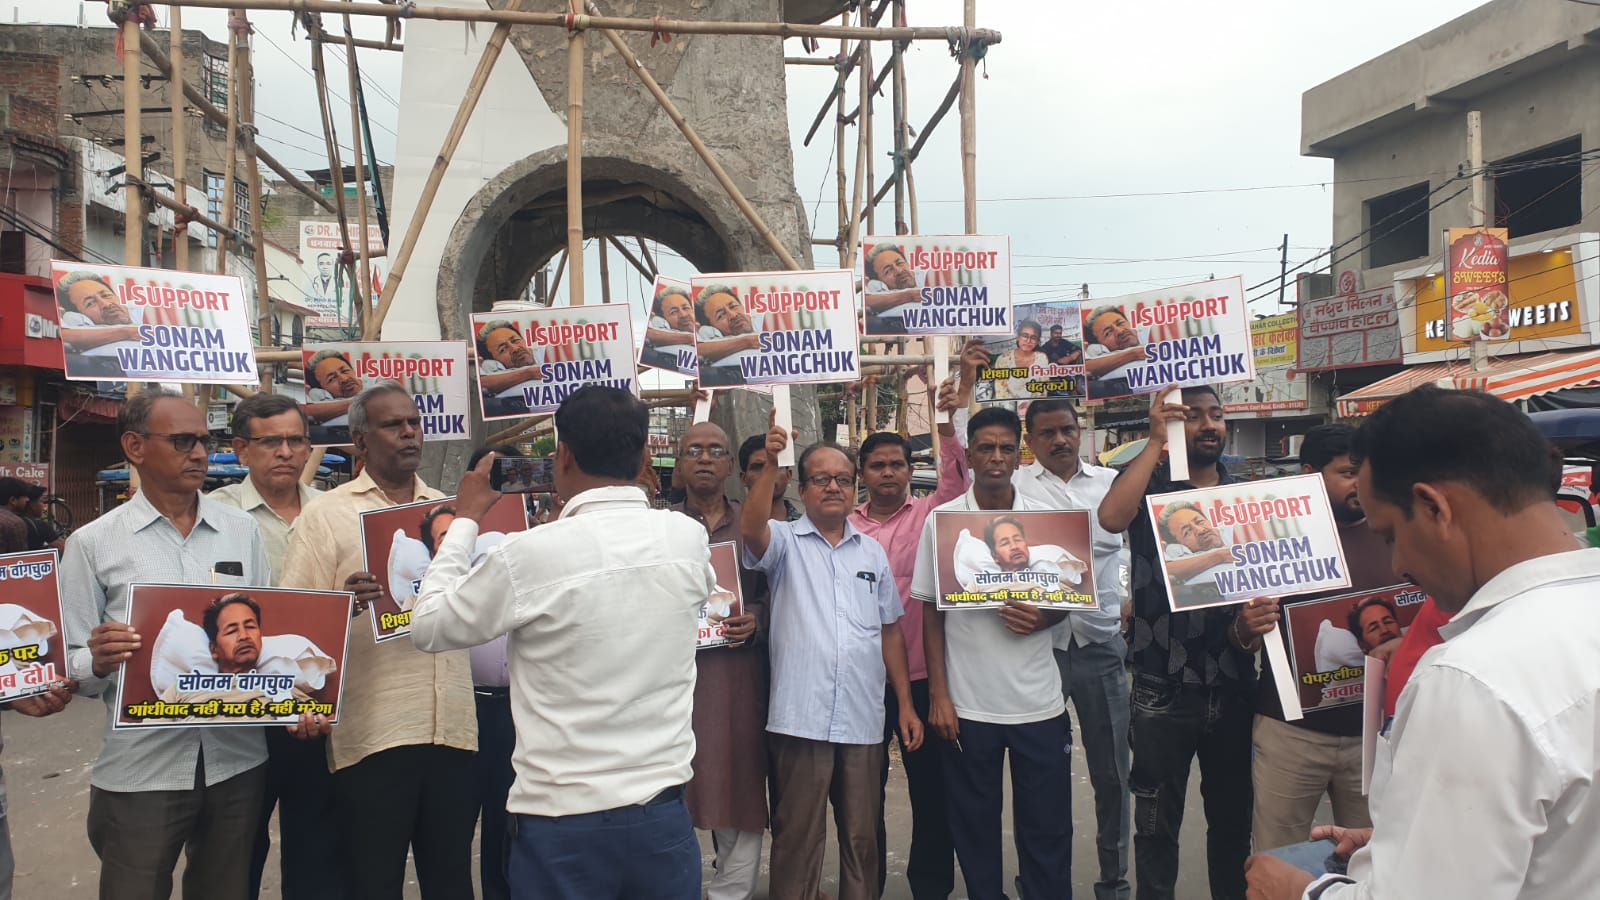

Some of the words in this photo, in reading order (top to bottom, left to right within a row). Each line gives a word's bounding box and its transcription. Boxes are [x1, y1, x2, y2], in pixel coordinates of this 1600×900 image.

[317, 225, 333, 236] DR.
[909, 252, 915, 270] I
[919, 251, 998, 270] SUPPORT
[1458, 247, 1500, 270] Kedia
[1453, 270, 1506, 284] SWEETS
[118, 285, 127, 305] I
[133, 285, 230, 311] SUPPORT
[744, 294, 750, 314] I
[756, 290, 841, 314] SUPPORT
[921, 286, 988, 307] SONAM
[903, 307, 1006, 328] WANGCHUK
[1130, 311, 1137, 329] I
[1142, 296, 1230, 327] SUPPORT
[1509, 301, 1570, 329] WEETS
[138, 325, 226, 350] SONAM
[525, 329, 532, 347] I
[536, 322, 619, 346] SUPPORT
[759, 329, 833, 354] SONAM
[117, 348, 252, 373] WANGCHUK
[1145, 334, 1222, 364] SONAM
[356, 359, 362, 378] I
[367, 358, 455, 378] SUPPORT
[541, 359, 612, 383] SONAM
[740, 351, 855, 378] WANGCHUK
[1012, 368, 1029, 379] का
[1126, 353, 1246, 388] WANGCHUK
[1027, 380, 1044, 392] बंद
[16, 466, 45, 478] Cake
[1209, 508, 1217, 528] I
[1220, 495, 1312, 526] SUPPORT
[1231, 536, 1313, 567] SONAM
[11, 561, 52, 579] वांगचुक
[974, 570, 1014, 585] सोनम
[1017, 568, 1060, 587] वांगचुक
[1215, 557, 1342, 594] WANGCHUK
[945, 590, 987, 603] गांधीवाद
[990, 589, 1010, 601] नहीं
[1010, 591, 1029, 600] मरा
[1045, 590, 1064, 602] नहीं
[1065, 591, 1093, 604] मरेगा
[14, 645, 39, 660] पर
[178, 669, 233, 691] सोनम
[238, 669, 295, 695] वांगचुक
[1302, 672, 1331, 685] पेपर
[1333, 666, 1363, 681] लीक
[128, 700, 189, 717] गांधीवाद
[193, 699, 221, 716] नहीं
[223, 702, 247, 715] मरा
[269, 699, 295, 715] नहीं
[297, 700, 333, 714] मरेगा
